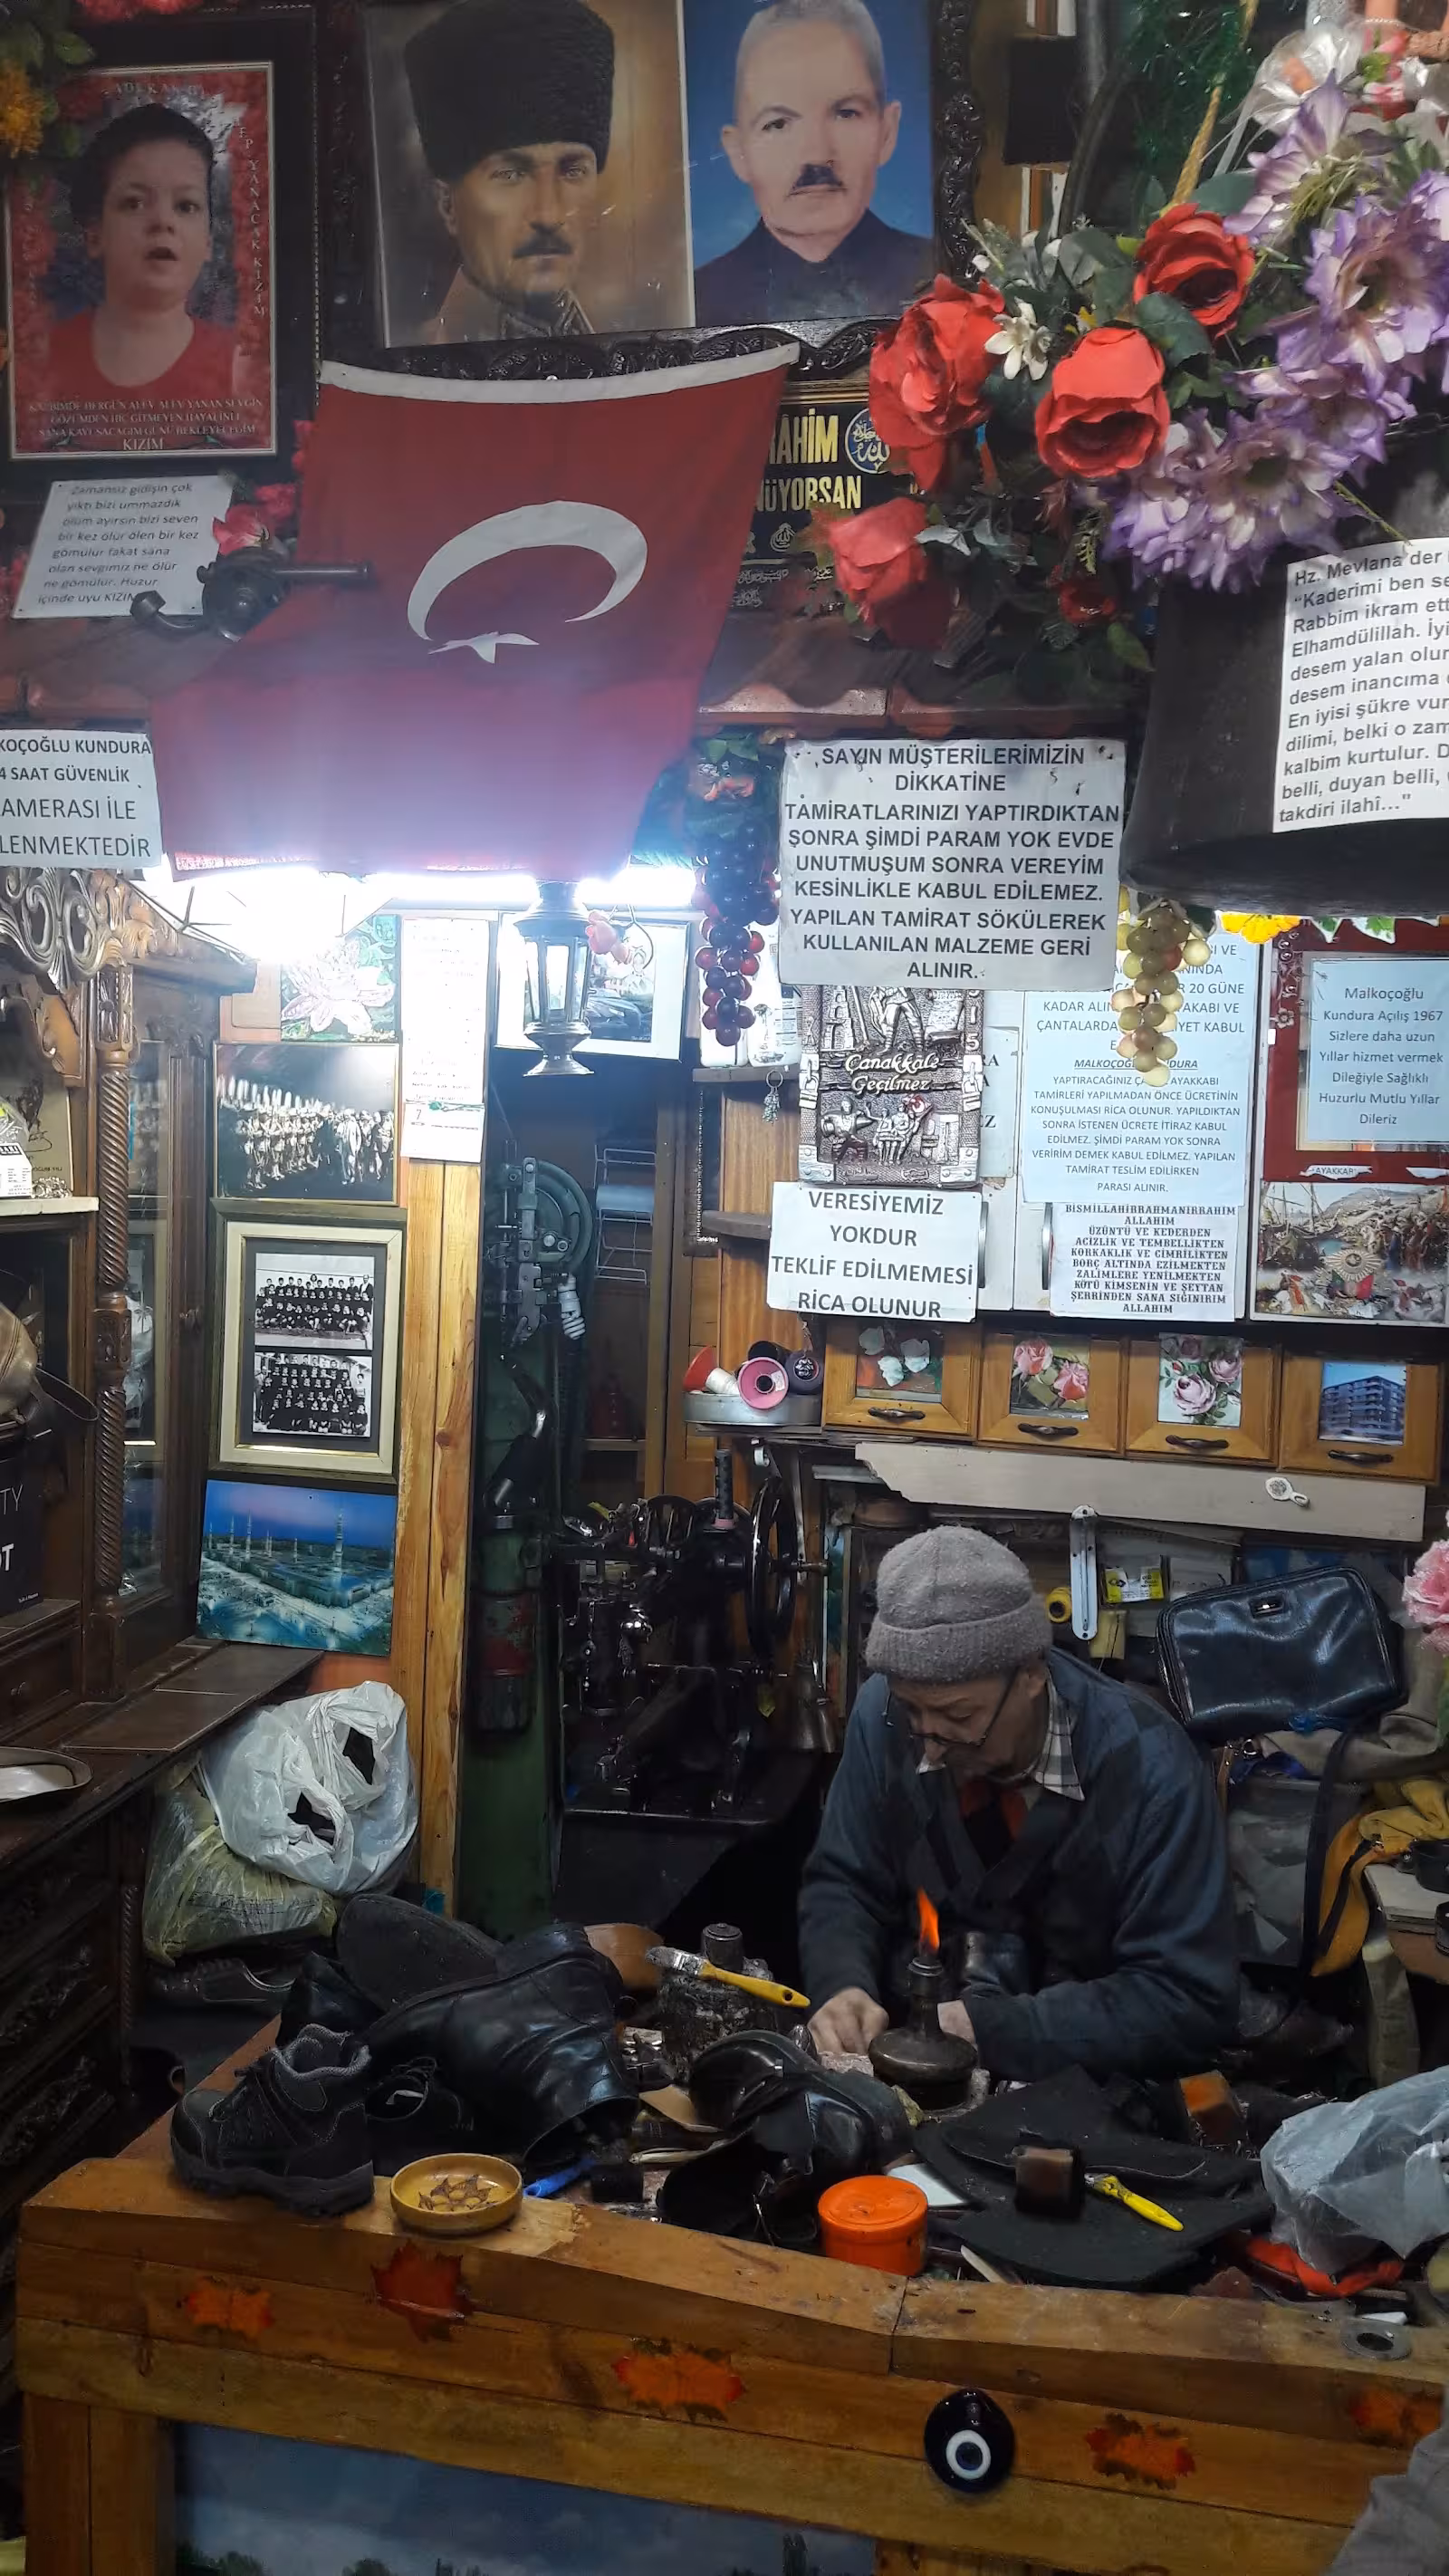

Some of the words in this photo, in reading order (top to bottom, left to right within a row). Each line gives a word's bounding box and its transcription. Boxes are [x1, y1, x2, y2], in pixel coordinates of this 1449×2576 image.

[1294, 570, 1320, 586] Hz.
[1327, 556, 1403, 580] Mevlana
[1410, 550, 1443, 565] der
[1389, 577, 1424, 591] ben
[1293, 609, 1358, 634] Rabbim
[1366, 602, 1418, 619] ikram
[1292, 623, 1420, 658] Elhamdülillah.
[1291, 659, 1347, 681] desem
[1352, 650, 1403, 673] yalan
[1290, 684, 1345, 705] desem
[1351, 673, 1439, 693] inancıma
[1288, 713, 1310, 729] En
[1316, 703, 1350, 728] iyisi
[1356, 699, 1410, 720] şükre
[1285, 730, 1337, 752] dilimi,
[1343, 722, 1387, 742] belki
[1395, 725, 1406, 736] o
[75, 739, 151, 754] KUNDURA
[822, 746, 882, 765] SAYIN
[888, 743, 1084, 769] MÜŞTERİLERİMİZİN
[1284, 755, 1340, 776] kalbim
[1348, 745, 1429, 765] kurtulur.
[11, 767, 49, 781] SAAT
[54, 765, 130, 783] GÜVENLİK
[896, 771, 1006, 791] DİKKATİNE
[1281, 780, 1322, 800] belli,
[1329, 774, 1386, 793] duyan
[1393, 768, 1440, 786] belli,
[0, 798, 100, 819] AMERASI
[108, 795, 136, 820] İLE
[784, 800, 958, 821] TAMİRATLARINIZI
[964, 804, 1118, 822] YAPTIRDIKTAN
[1279, 801, 1335, 822] takdiri
[866, 826, 920, 851] ŞİMDİ
[926, 831, 1000, 847] PARAM
[1007, 831, 1051, 848] YOK
[1058, 831, 1114, 848] EVDE
[797, 855, 925, 876] UNUTMUŞUM
[932, 857, 1004, 873] SONRA
[1011, 854, 1103, 875] VEREYİM
[795, 877, 911, 898] KESİNLİKLE
[917, 882, 987, 899] KABUL
[994, 879, 1102, 901] EDİLEMEZ.
[790, 908, 875, 926] YAPILAN
[881, 908, 971, 928] TAMİRAT
[977, 908, 1106, 930] SÖKÜLEREK
[804, 934, 928, 952] KULLANILAN
[936, 937, 1033, 955] MALZEME
[1041, 937, 1090, 956] GERİ
[1221, 945, 1237, 956] VE
[907, 962, 977, 978] ALINIR.
[1189, 983, 1204, 994] 20
[1208, 981, 1244, 994] GÜNE
[1345, 987, 1424, 1002] Malkoçoğlu
[1043, 1001, 1084, 1012] KADAR
[1223, 1003, 1239, 1014] VE
[1324, 1010, 1374, 1021] Kundura
[1377, 1010, 1410, 1024] Açılış
[1413, 1010, 1444, 1021] 1967
[1204, 1022, 1245, 1033] KABUL
[1329, 1030, 1369, 1042] Sizlere
[1372, 1031, 1402, 1042] daha
[1406, 1033, 1435, 1042] uzun
[1319, 1051, 1349, 1062] Yıllar
[1353, 1052, 1394, 1062] hizmet
[1397, 1053, 1444, 1063] vermek
[852, 1075, 930, 1094] Geçilmez
[1053, 1074, 1132, 1085] YAPTIRACAĞINIZ
[1170, 1077, 1219, 1085] AYAKKABI
[1332, 1072, 1384, 1085] Dileğiyle
[1034, 1089, 1084, 1100] TAMİRLERİ
[1088, 1091, 1151, 1100] YAPILMADAN
[1154, 1090, 1182, 1101] ÖNCE
[1185, 1090, 1238, 1101] ÜCRETİNİN
[1319, 1092, 1366, 1103] Huzurlu
[1369, 1093, 1406, 1104] Mutlu
[1410, 1094, 1440, 1104] Yıllar
[1031, 1105, 1101, 1116] KONUŞULMASI
[1104, 1104, 1126, 1115] RİCA
[1128, 1106, 1173, 1115] OLUNUR.
[1176, 1107, 1241, 1116] YAPILDIKTAN
[1042, 1120, 1076, 1129] SONRA
[1121, 1120, 1158, 1130] ÜCRETE
[1195, 1122, 1227, 1131] KABUL
[1359, 1113, 1397, 1125] Dileriz
[1094, 1134, 1122, 1146] ŞİMDİ
[1125, 1136, 1161, 1145] PARAM
[1164, 1137, 1184, 1145] YOK
[1186, 1137, 1221, 1146] SONRA
[1032, 1149, 1072, 1158] VERİRİM
[1075, 1150, 1109, 1159] DEMEK
[1112, 1151, 1144, 1160] KABUL
[1194, 1152, 1235, 1161] YAPILAN
[1066, 1164, 1110, 1174] TAMİRAT
[1112, 1165, 1147, 1175] TESLİM
[1149, 1166, 1199, 1176] EDİLİRKEN
[1098, 1182, 1131, 1191] PARASI
[1134, 1183, 1168, 1192] ALINIR.
[809, 1191, 944, 1215] VERESİYEMİZ
[1124, 1216, 1175, 1226] ALLAHIM
[830, 1225, 916, 1246] YOKDUR
[1089, 1226, 1130, 1237] ÜZÜNTÜ
[1136, 1227, 1149, 1235] VE
[1154, 1227, 1211, 1237] KEDERDEN
[1075, 1237, 1117, 1246] ACİZLİK
[1121, 1238, 1135, 1246] VE
[1071, 1248, 1132, 1257] KORKAKLIK
[1137, 1249, 1150, 1258] VE
[771, 1254, 836, 1275] TEKLİF
[843, 1258, 973, 1285] EDİLMEMESİ
[1072, 1258, 1099, 1270] BORÇ
[1104, 1259, 1151, 1269] ALTINDA
[1077, 1269, 1138, 1281] ZALİMLERE
[1143, 1270, 1221, 1281] YENİLMEKTEN
[1074, 1280, 1099, 1290] KÖTÜ
[1164, 1283, 1176, 1291] VE
[1181, 1283, 1223, 1293] ŞEYTAN
[798, 1289, 845, 1311] RİCA
[851, 1296, 941, 1318] OLUNUR
[1070, 1290, 1131, 1302] ŞERRİNDEN
[1137, 1293, 1165, 1302] SANA
[1169, 1292, 1225, 1303] SIĞINIRIM
[1123, 1303, 1173, 1313] ALLAHIM
